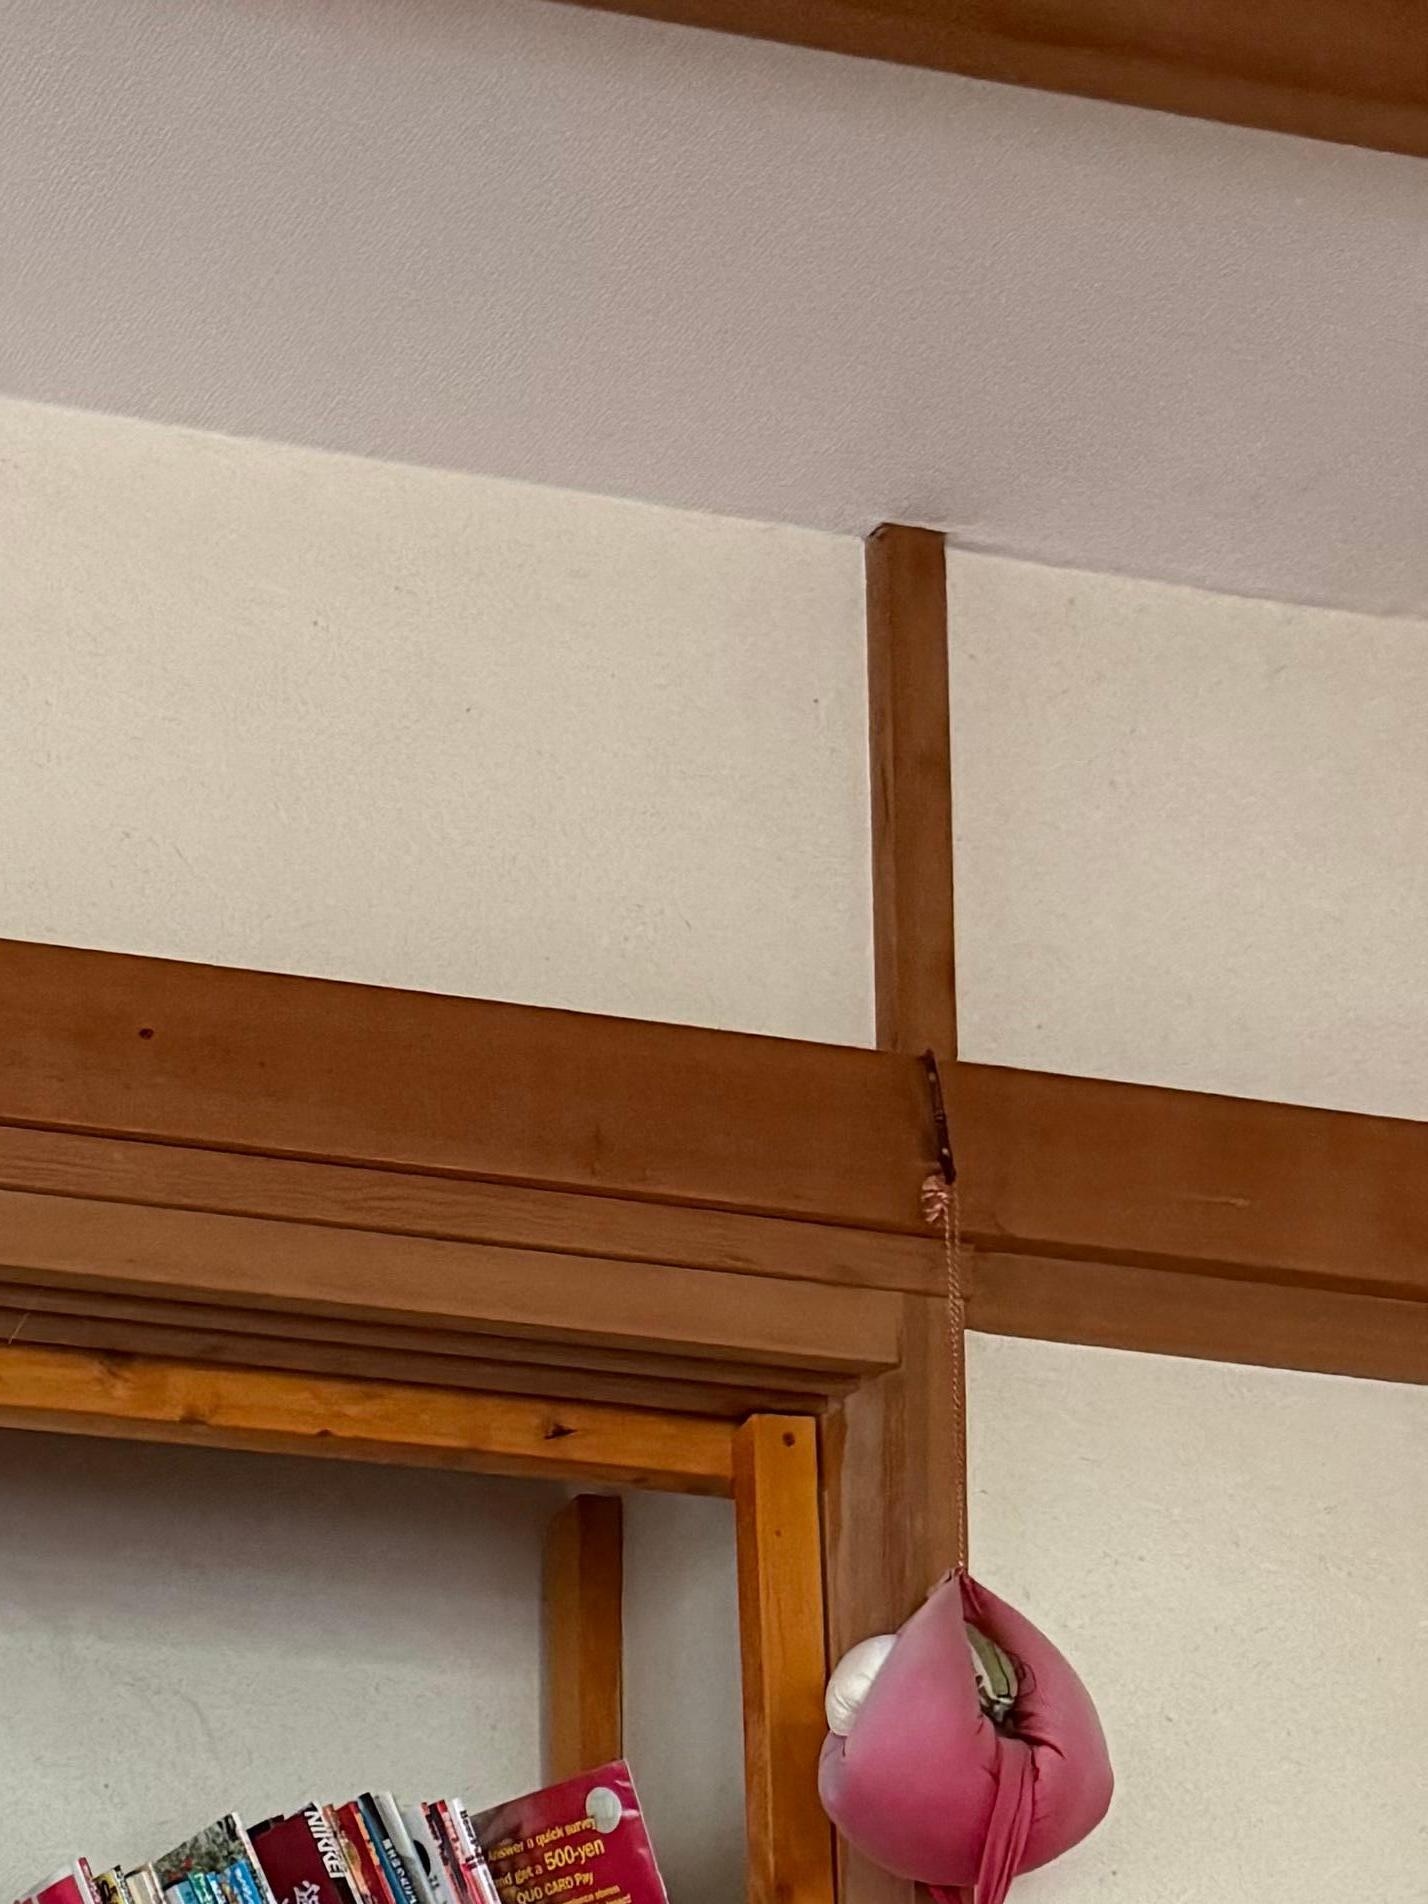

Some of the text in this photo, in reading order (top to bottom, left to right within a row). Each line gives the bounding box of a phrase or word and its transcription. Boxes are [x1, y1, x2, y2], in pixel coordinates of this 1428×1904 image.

[543, 1837, 606, 1872] 500-yen
[544, 1877, 575, 1899] CARD
[575, 1870, 595, 1888] Pay
